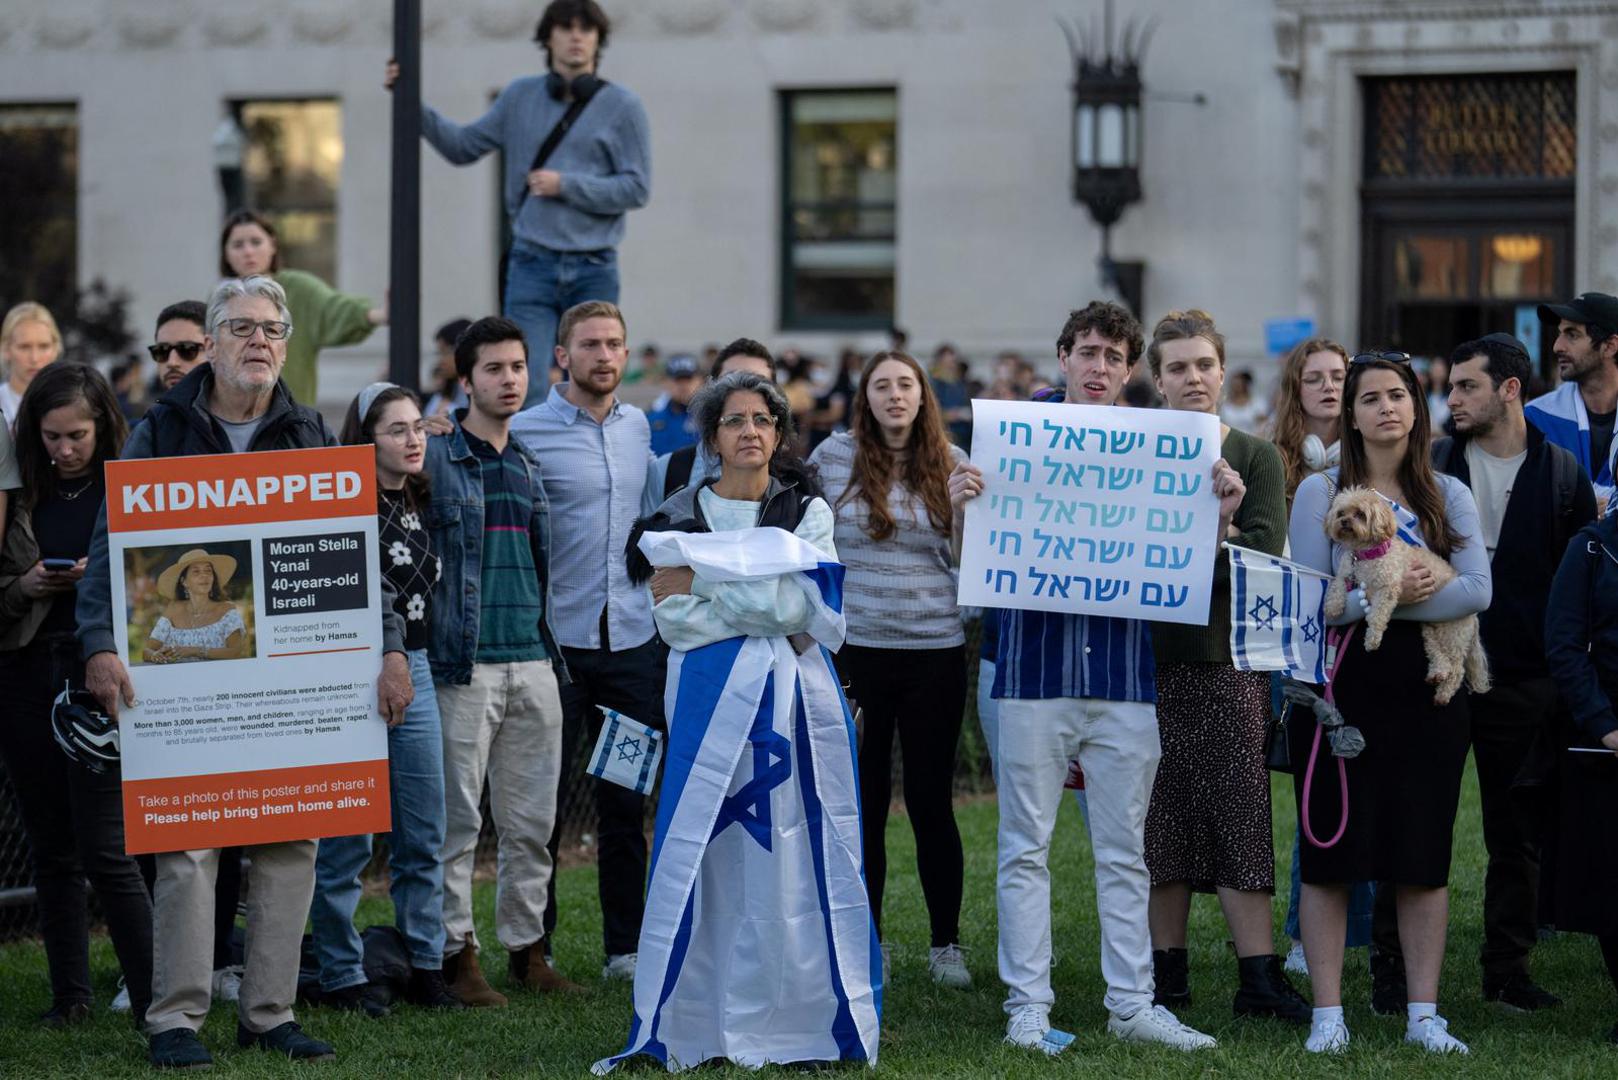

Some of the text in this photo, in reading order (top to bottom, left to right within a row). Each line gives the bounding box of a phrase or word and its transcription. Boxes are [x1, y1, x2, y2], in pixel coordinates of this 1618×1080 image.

[1000, 419, 1202, 460] עם ישראל חי
[1000, 456, 1201, 497] עם ישראל חי
[122, 470, 361, 513] KIDNAPPED
[991, 493, 1194, 533] עם ישראל חי
[270, 536, 358, 555] Moran Stella
[990, 529, 1192, 569] עם ישראל חי
[270, 558, 309, 572] Yanai
[271, 572, 358, 594] 40-years-old
[986, 567, 1188, 607] עם ישראל חי
[272, 594, 315, 609] Israeli
[273, 620, 339, 635] Kidnapped from
[290, 635, 312, 643] home
[315, 633, 325, 642] by
[328, 631, 357, 640] Hamas
[144, 707, 163, 715] Israel
[194, 703, 212, 711] Gaza
[236, 700, 252, 708] Their
[255, 697, 299, 706] whereabouts
[327, 692, 358, 700] unknown.
[146, 696, 175, 706] October
[192, 694, 213, 704] nearly
[231, 690, 263, 699] innocent
[265, 688, 296, 696] civilians
[318, 683, 352, 692] abducted
[173, 718, 193, 727] 3,000
[196, 717, 224, 725] women,
[297, 708, 323, 717] ranging
[136, 730, 161, 738] months
[181, 736, 207, 745] brutally
[209, 732, 244, 742] separated
[264, 729, 283, 737] loved
[304, 727, 313, 735] by
[137, 776, 375, 807] Take a photo of this poster and share it
[144, 795, 370, 825] Please help bring them home alive.
